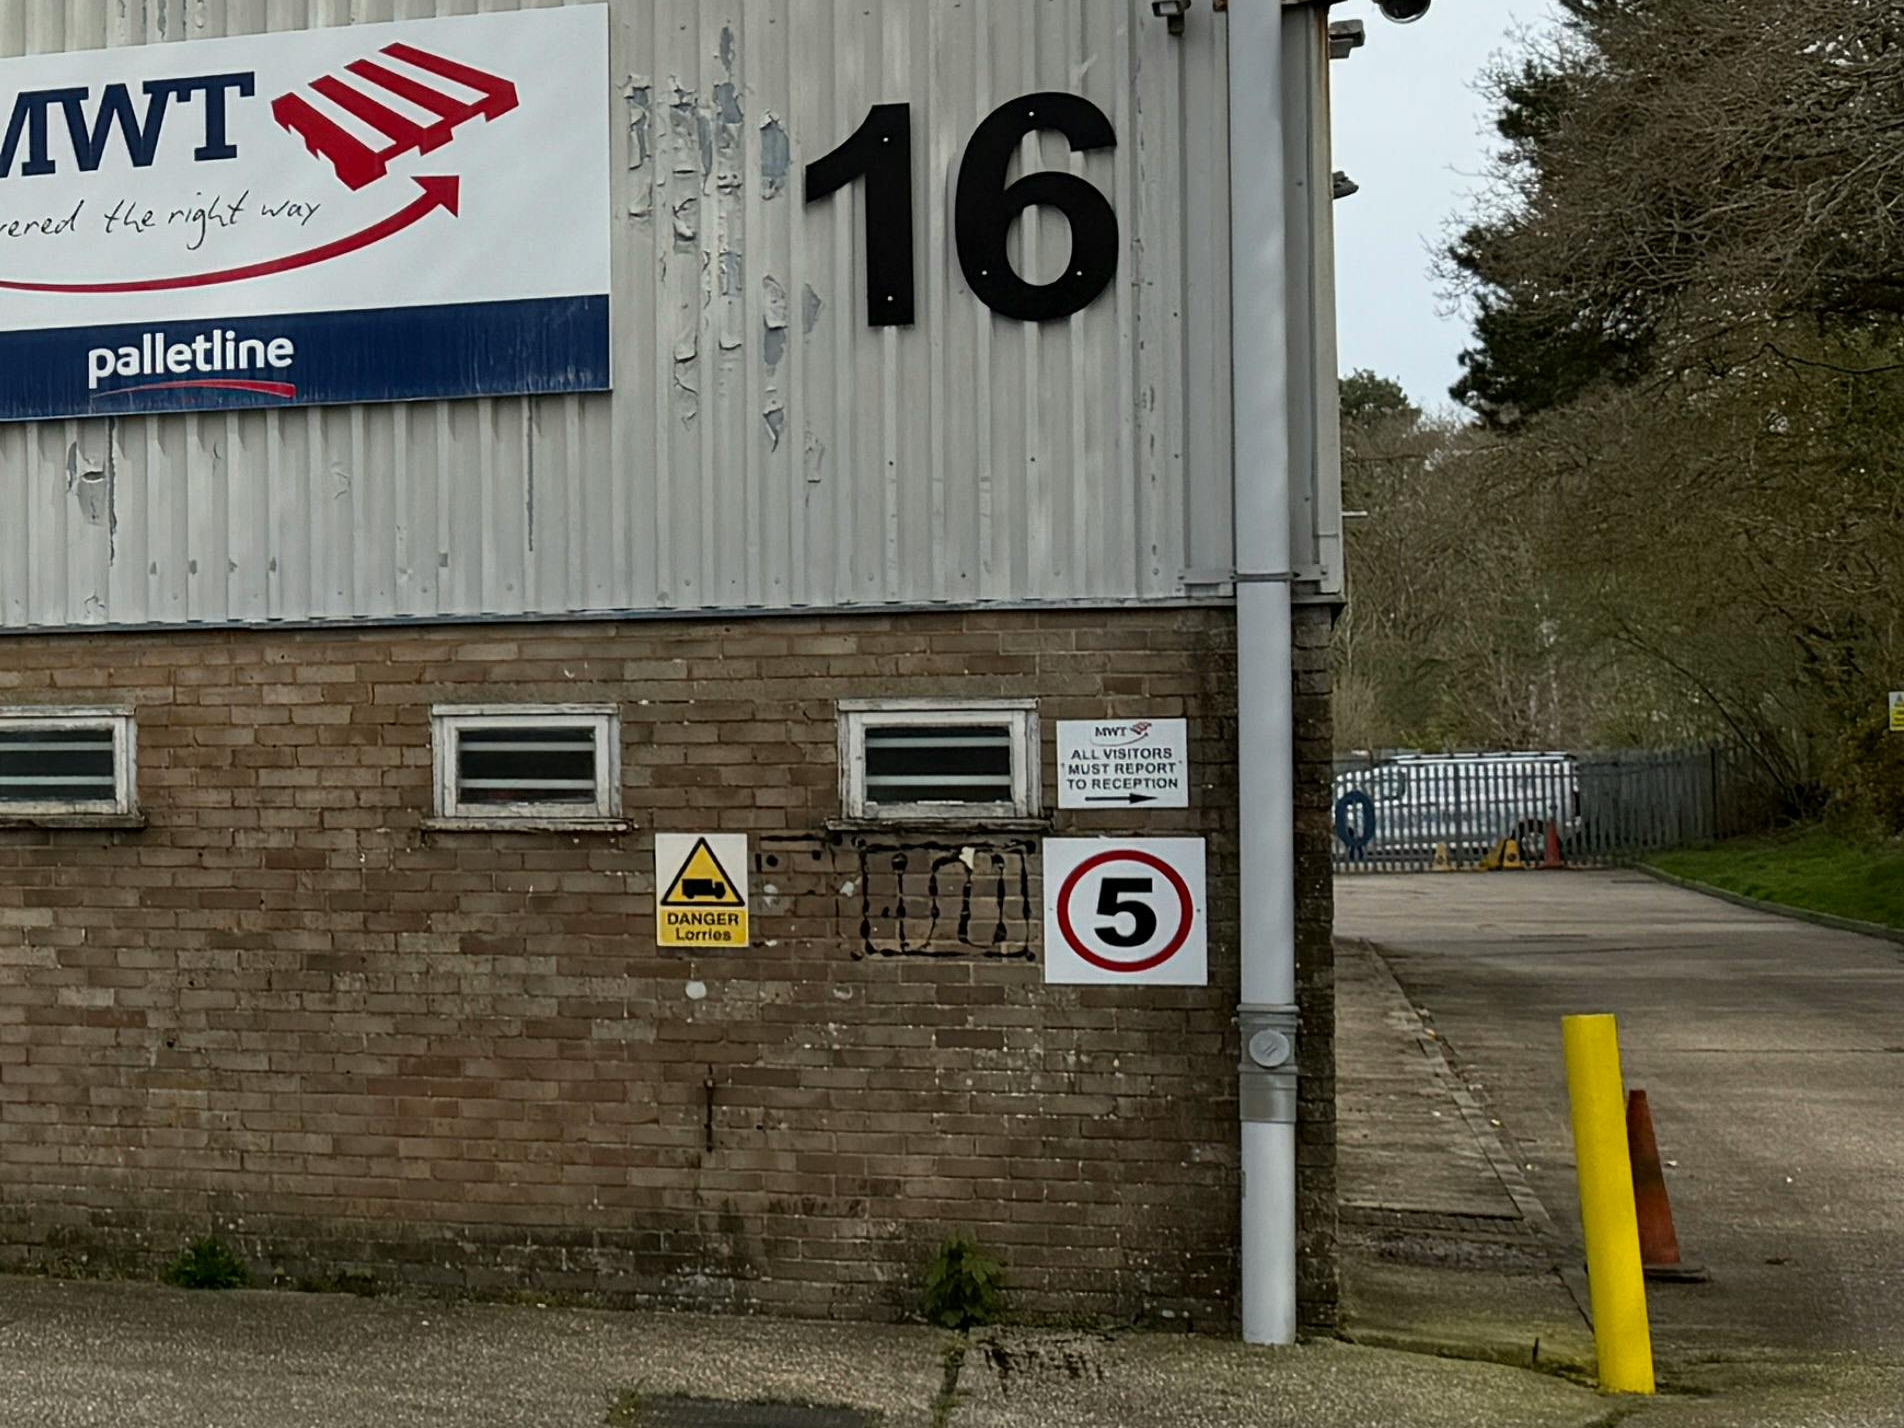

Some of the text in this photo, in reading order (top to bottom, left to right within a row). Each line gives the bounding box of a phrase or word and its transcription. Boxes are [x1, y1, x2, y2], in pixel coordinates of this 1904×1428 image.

[804, 91, 1120, 327] 16
[103, 198, 156, 235] the
[167, 189, 250, 251] right
[261, 200, 322, 227] way
[88, 329, 295, 389] palletline
[1094, 726, 1128, 737] MWT
[1071, 747, 1173, 760] ALL VISITORS
[1068, 762, 1176, 775] MUST REPORT
[1067, 777, 1178, 790] TO RECEPTION
[667, 912, 739, 926] DANGER
[1094, 877, 1157, 947] 5
[676, 927, 732, 941] Lorries
